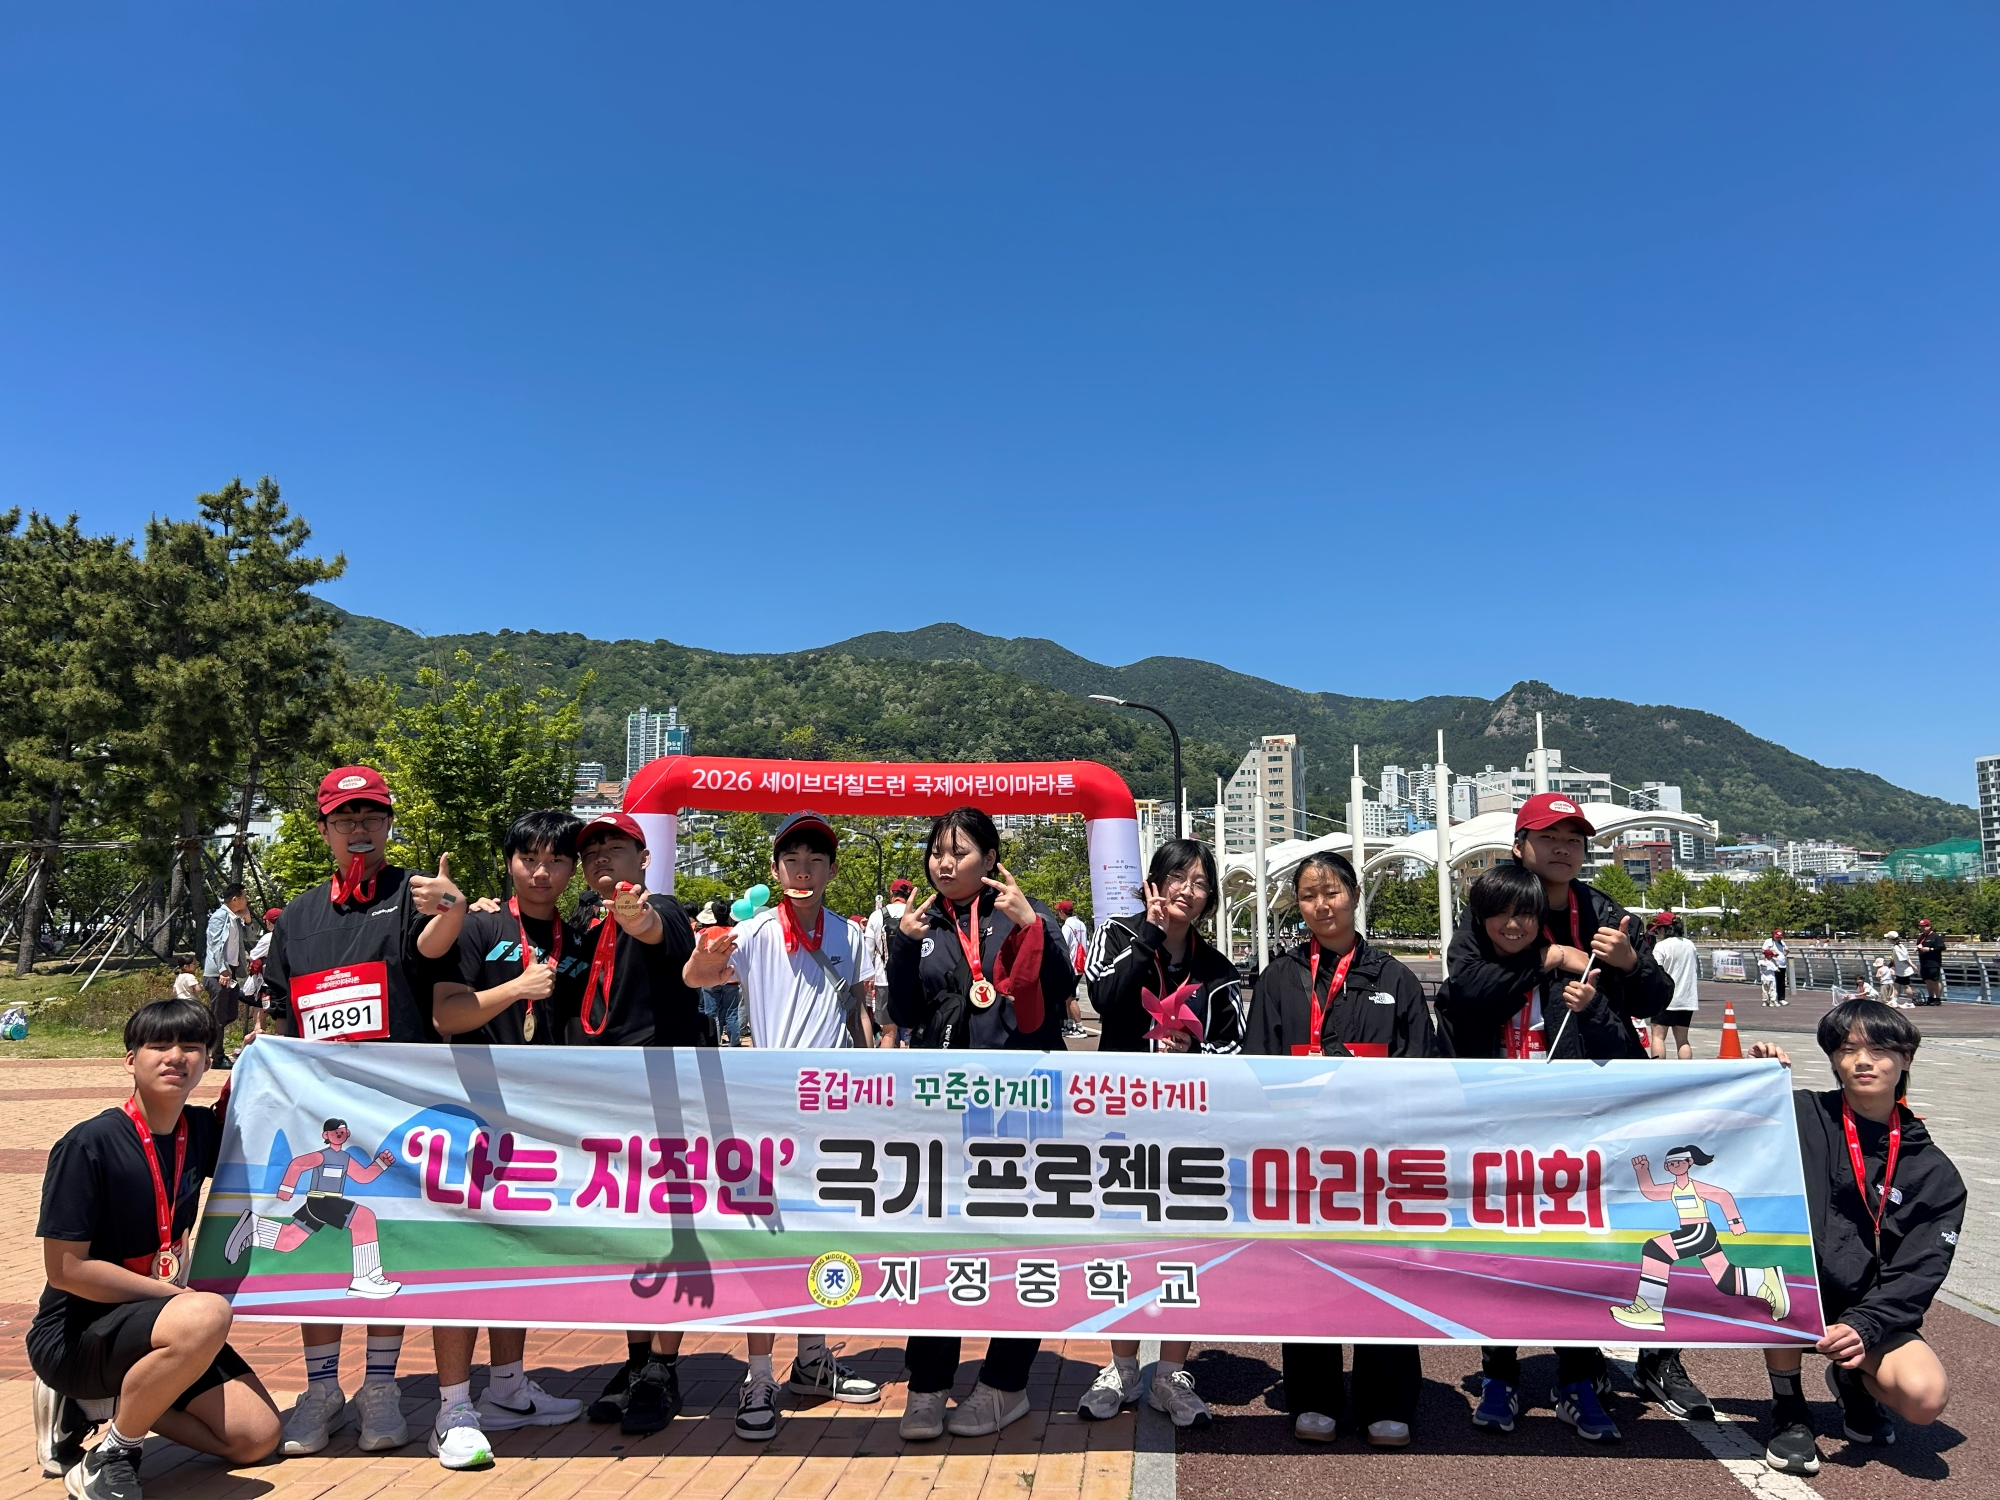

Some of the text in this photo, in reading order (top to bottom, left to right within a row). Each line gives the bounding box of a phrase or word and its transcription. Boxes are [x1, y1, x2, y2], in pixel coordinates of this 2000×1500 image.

[691, 768, 1076, 797] 2026 세이브더칠드런 국제어린이마라톤
[308, 1005, 372, 1034] 14891
[944, 1024, 953, 1041] new
[796, 1070, 1208, 1116] 즐겁게! 꾸준하게! 성실하게!
[816, 1139, 943, 1219] 극기
[966, 1143, 1229, 1222] 프로젝트
[1252, 1146, 1449, 1227] 마라톤
[1472, 1148, 1605, 1229] 대회
[825, 1253, 847, 1261] MIDDLE
[846, 1258, 860, 1283] SCHOOL
